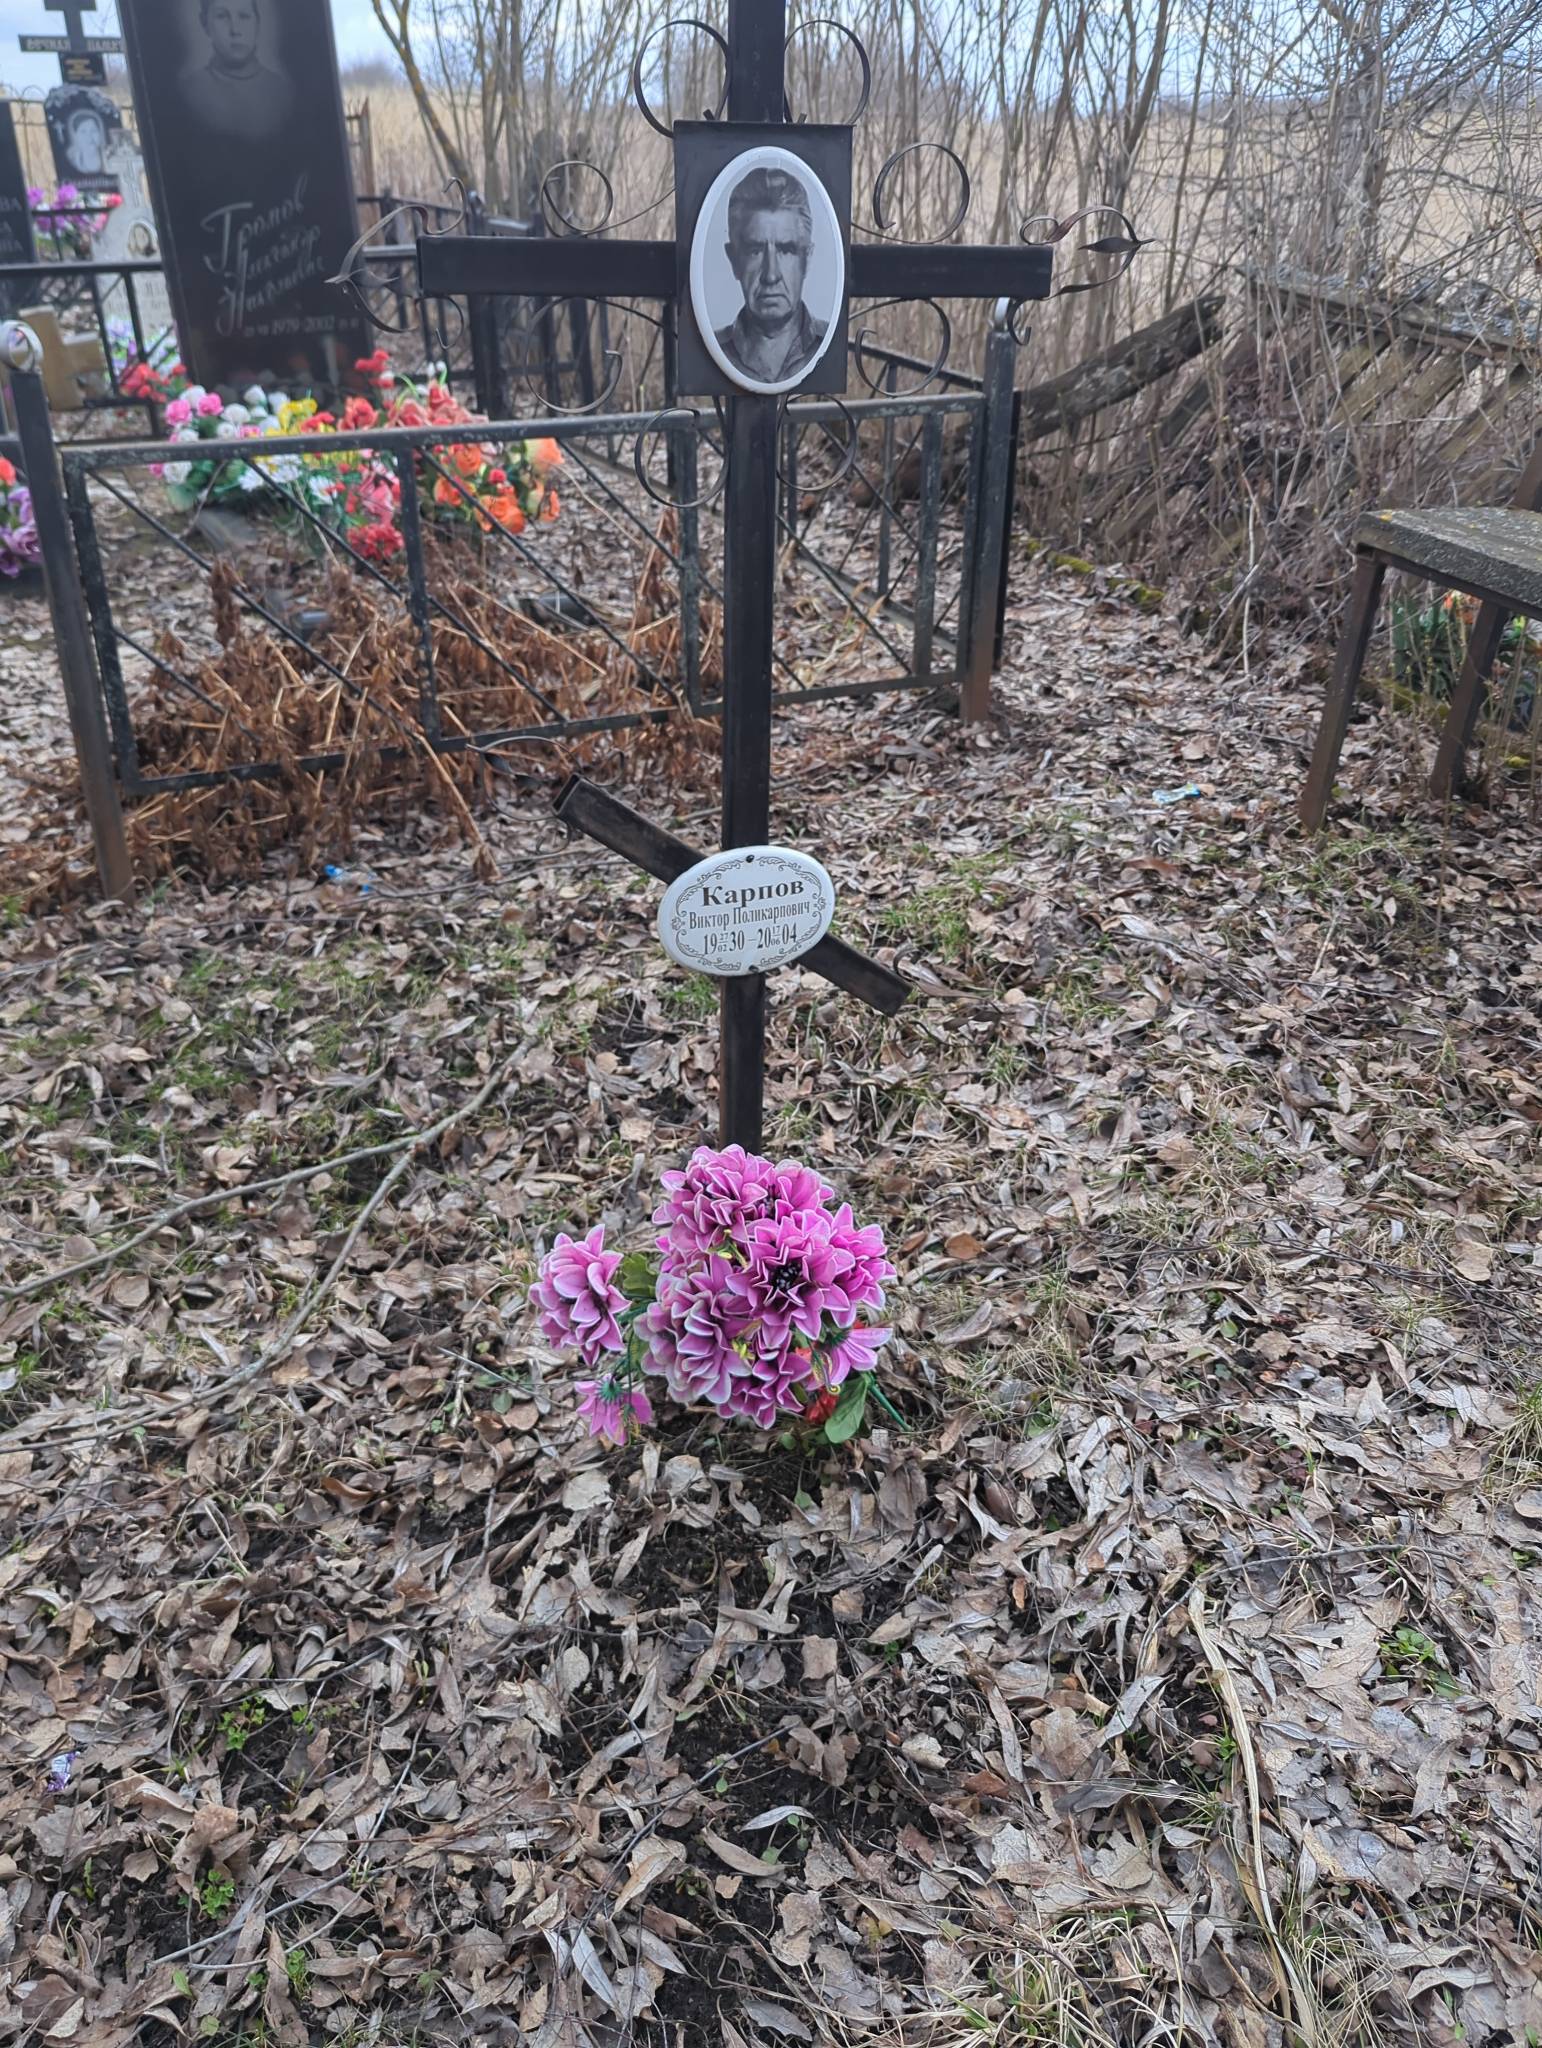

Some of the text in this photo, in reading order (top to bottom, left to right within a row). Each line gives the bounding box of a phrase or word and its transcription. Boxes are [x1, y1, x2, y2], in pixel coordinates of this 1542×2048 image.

[702, 880, 804, 907] Карпов
[689, 901, 810, 931] Виктор Поликарпович
